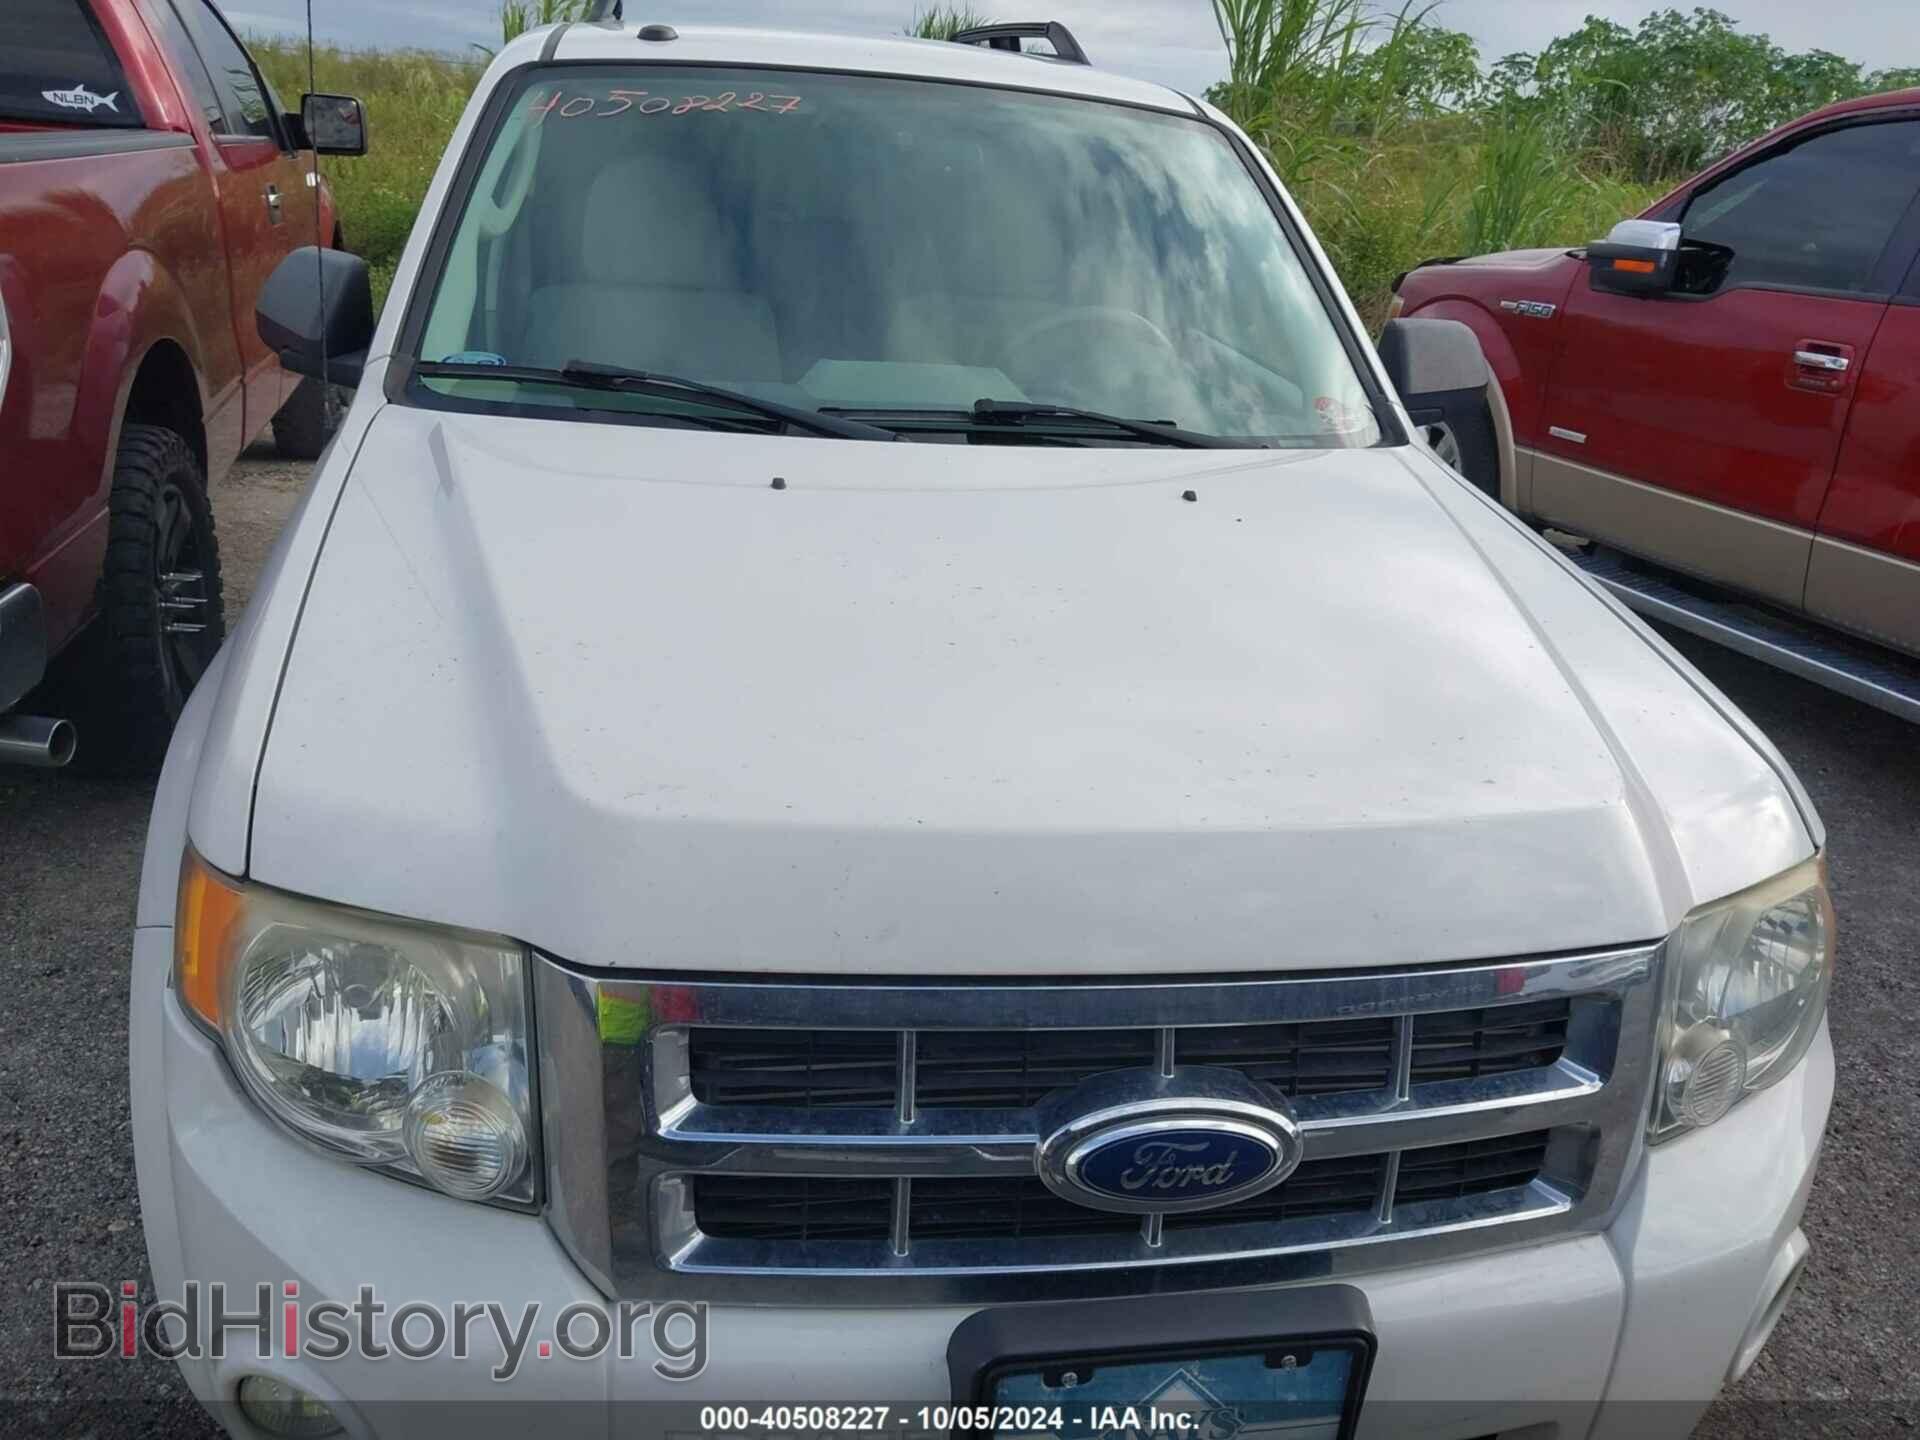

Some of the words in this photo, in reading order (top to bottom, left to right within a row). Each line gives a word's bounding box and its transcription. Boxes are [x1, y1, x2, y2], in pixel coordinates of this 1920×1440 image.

[53, 92, 95, 105] NLBN
[528, 90, 802, 129] 40508227
[1120, 1142, 1238, 1190] Ford
